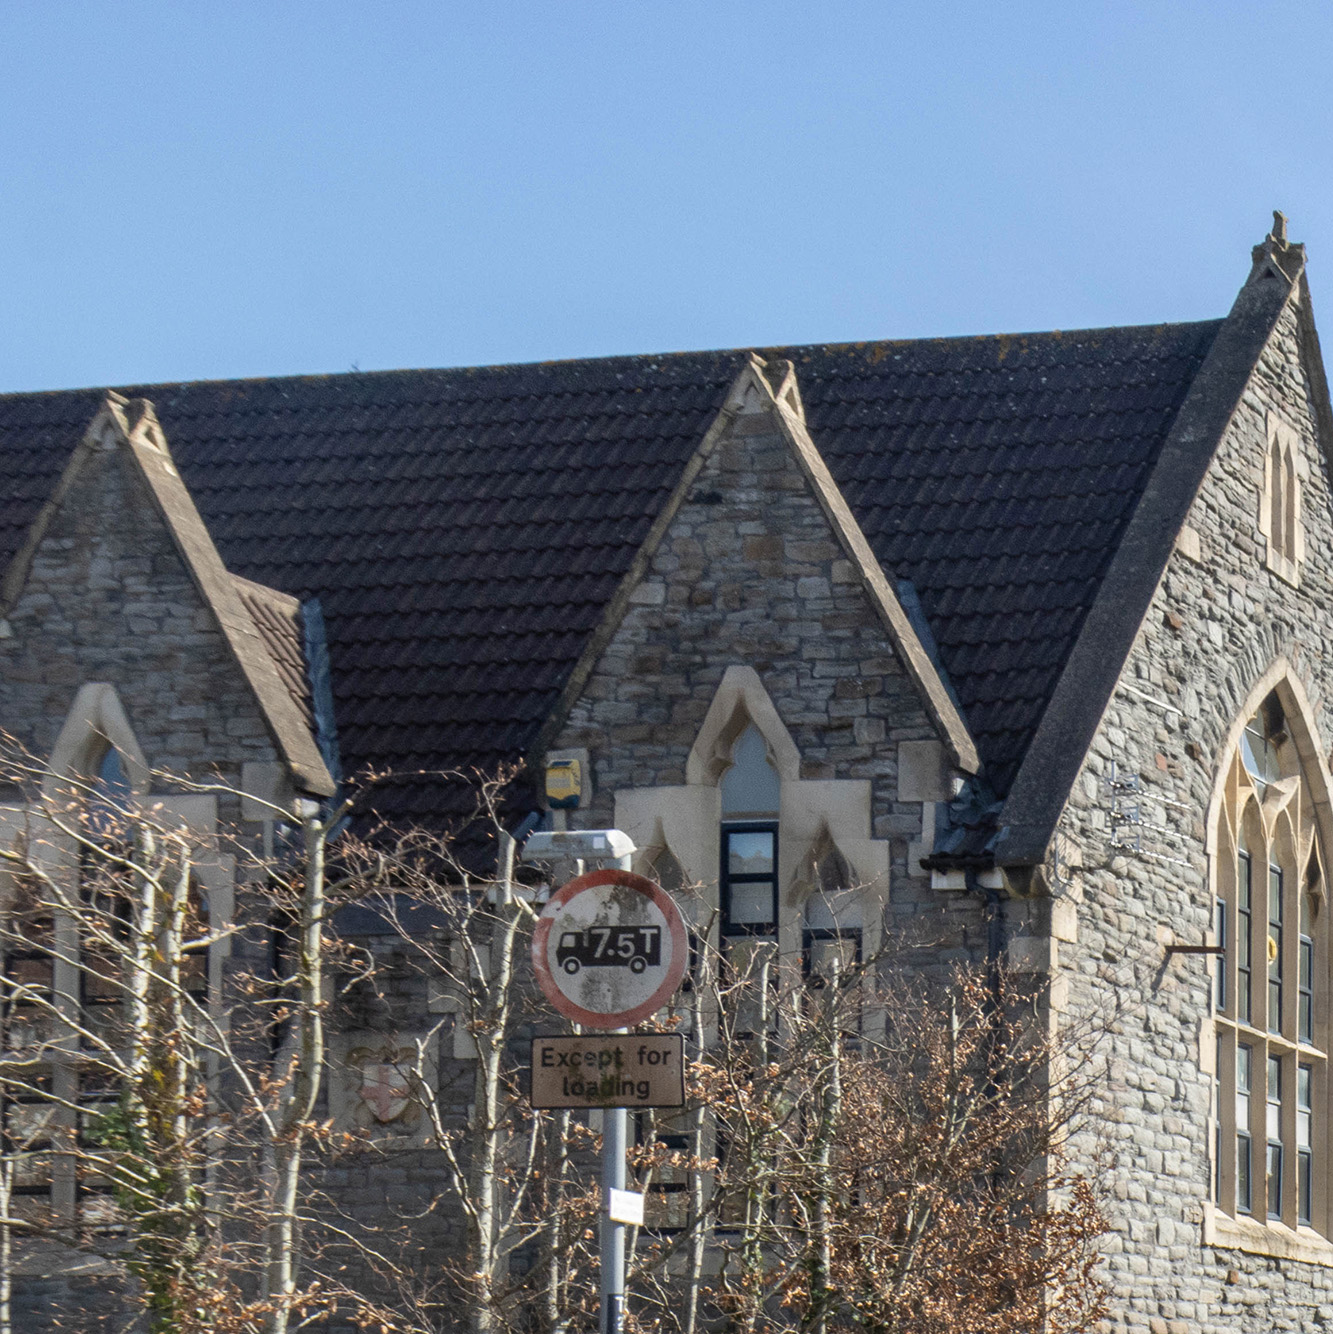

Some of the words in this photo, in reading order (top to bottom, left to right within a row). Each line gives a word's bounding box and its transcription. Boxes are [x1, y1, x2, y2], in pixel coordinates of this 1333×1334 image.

[540, 1046, 624, 1070] Except
[637, 1045, 672, 1067] for
[563, 1076, 650, 1100] loading
